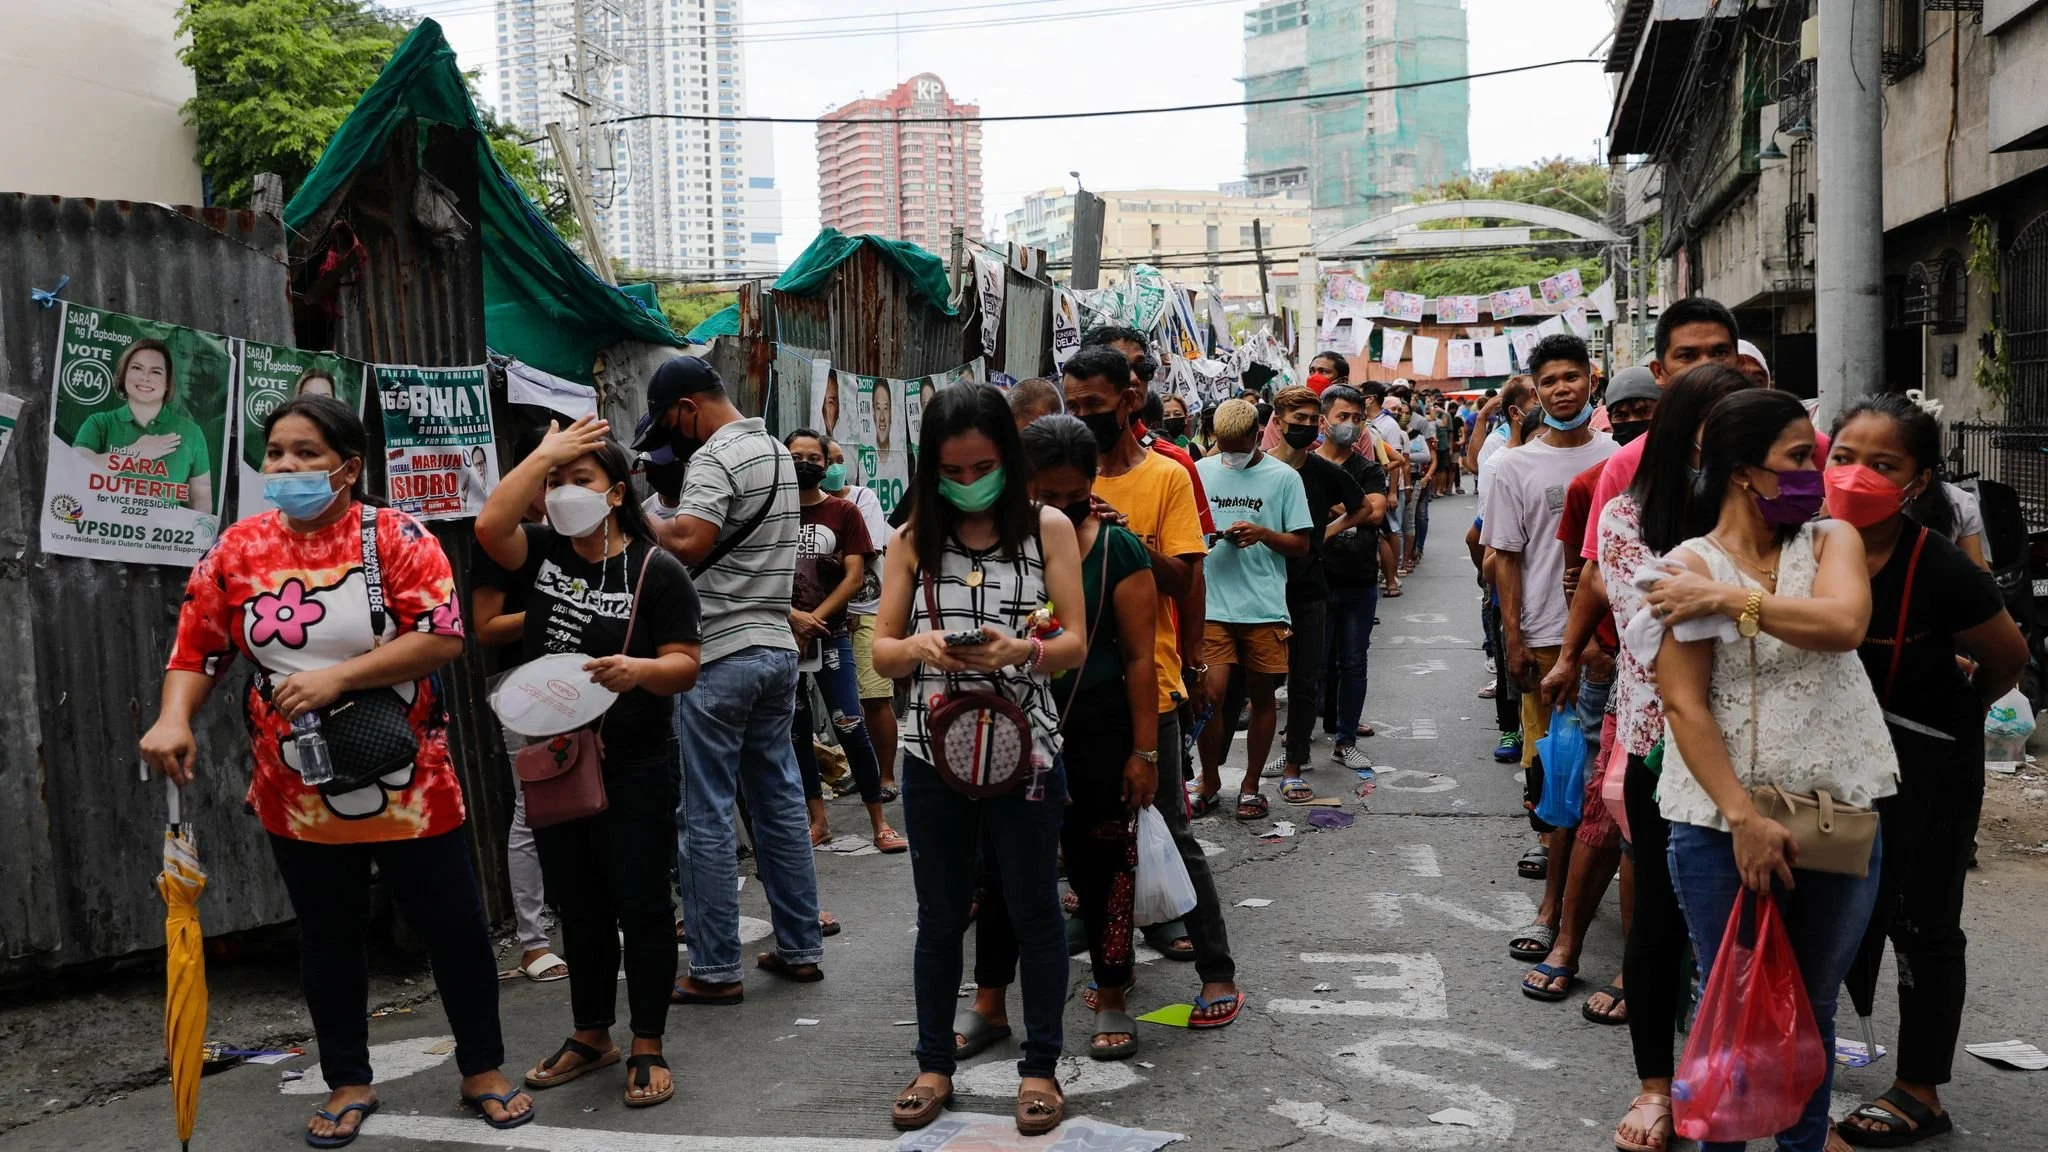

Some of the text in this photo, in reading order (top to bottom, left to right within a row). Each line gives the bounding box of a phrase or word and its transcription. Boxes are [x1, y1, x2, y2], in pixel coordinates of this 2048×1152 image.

[918, 81, 942, 102] KP
[75, 326, 86, 339] ng
[67, 342, 112, 361] VOTE
[253, 360, 262, 372] ng
[71, 368, 103, 390] #04
[247, 376, 288, 390] VOTE
[107, 454, 168, 477] SARA
[411, 454, 462, 470] MARJUN
[88, 473, 190, 501] DUTERTE
[390, 472, 458, 501] ISIDRO
[97, 493, 180, 510] for VICE PRESIDENT
[121, 506, 149, 516] 2022
[1211, 495, 1263, 513] THRASHER
[75, 519, 195, 545] VPSDDS 2022
[799, 523, 815, 534] HE
[51, 532, 65, 540] Vice
[66, 534, 100, 545] President
[101, 537, 117, 546] Sara
[118, 540, 144, 549] Duterte
[145, 542, 172, 551] Diehard
[368, 586, 384, 612] 980
